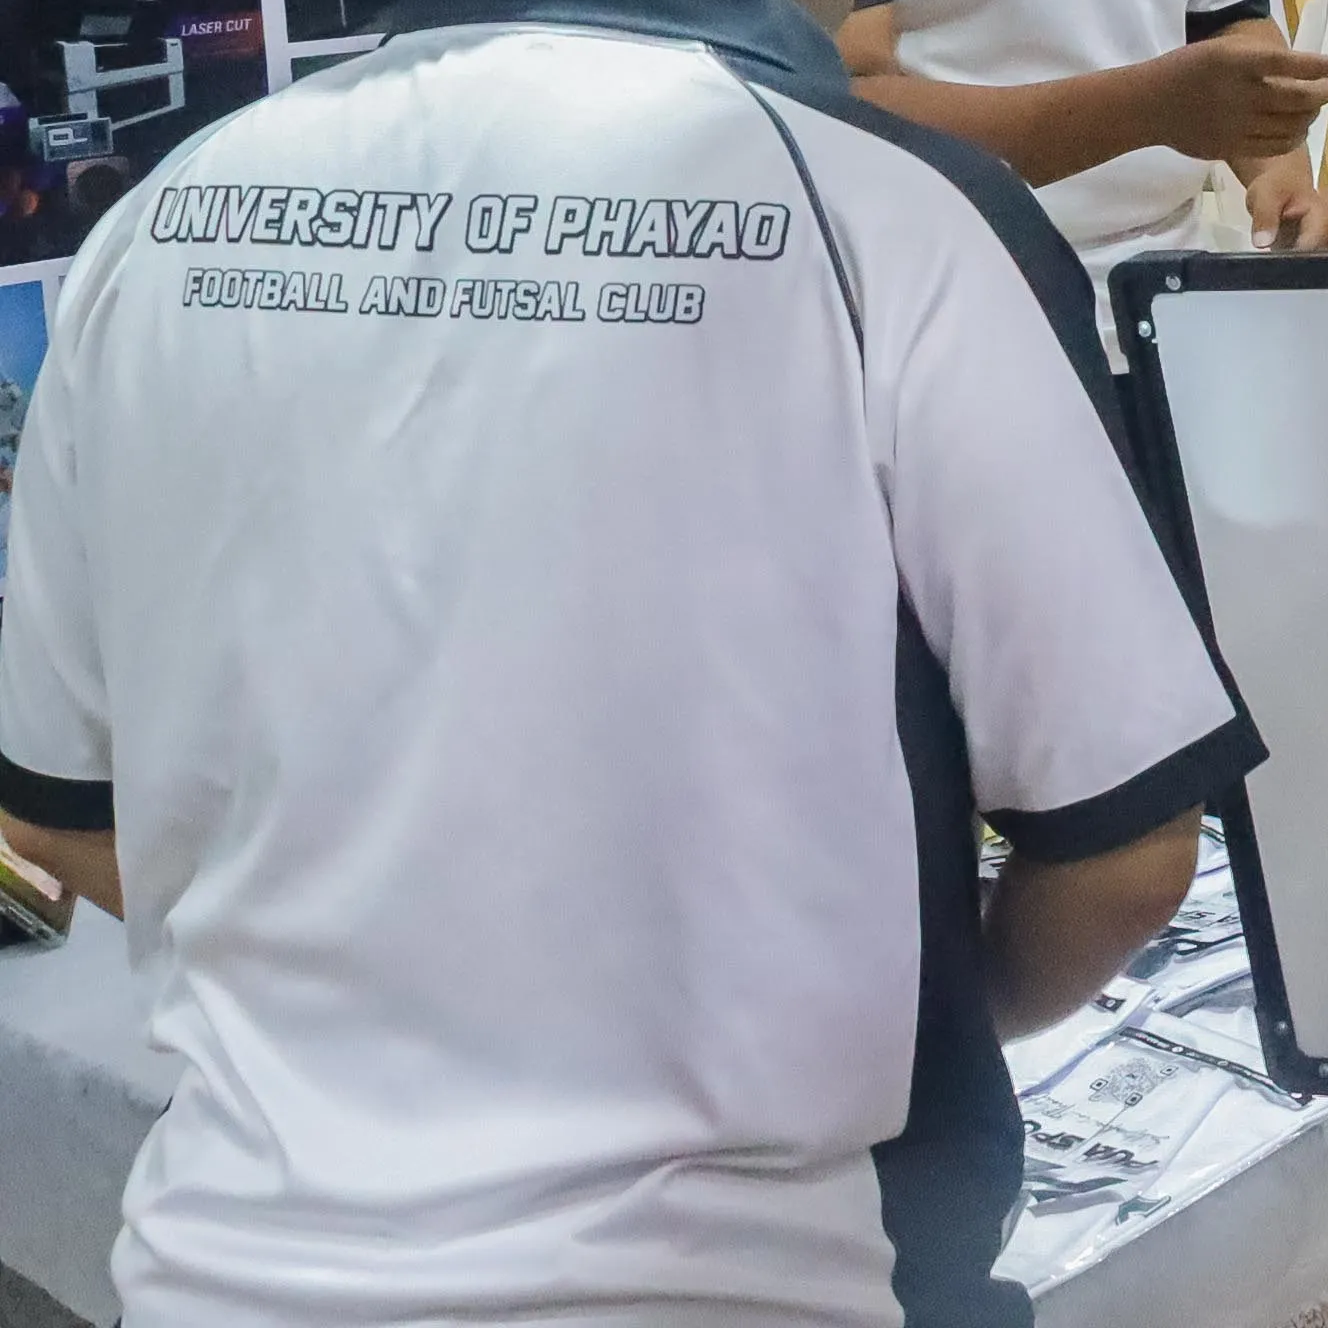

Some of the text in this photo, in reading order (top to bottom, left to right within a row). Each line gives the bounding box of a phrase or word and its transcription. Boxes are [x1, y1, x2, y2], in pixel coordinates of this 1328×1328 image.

[181, 18, 253, 37] LASER CUT
[151, 186, 790, 260] UNIVERSITY OF PHAYAO
[183, 267, 704, 324] FOOTBALL AND FUTSAL CLUB
